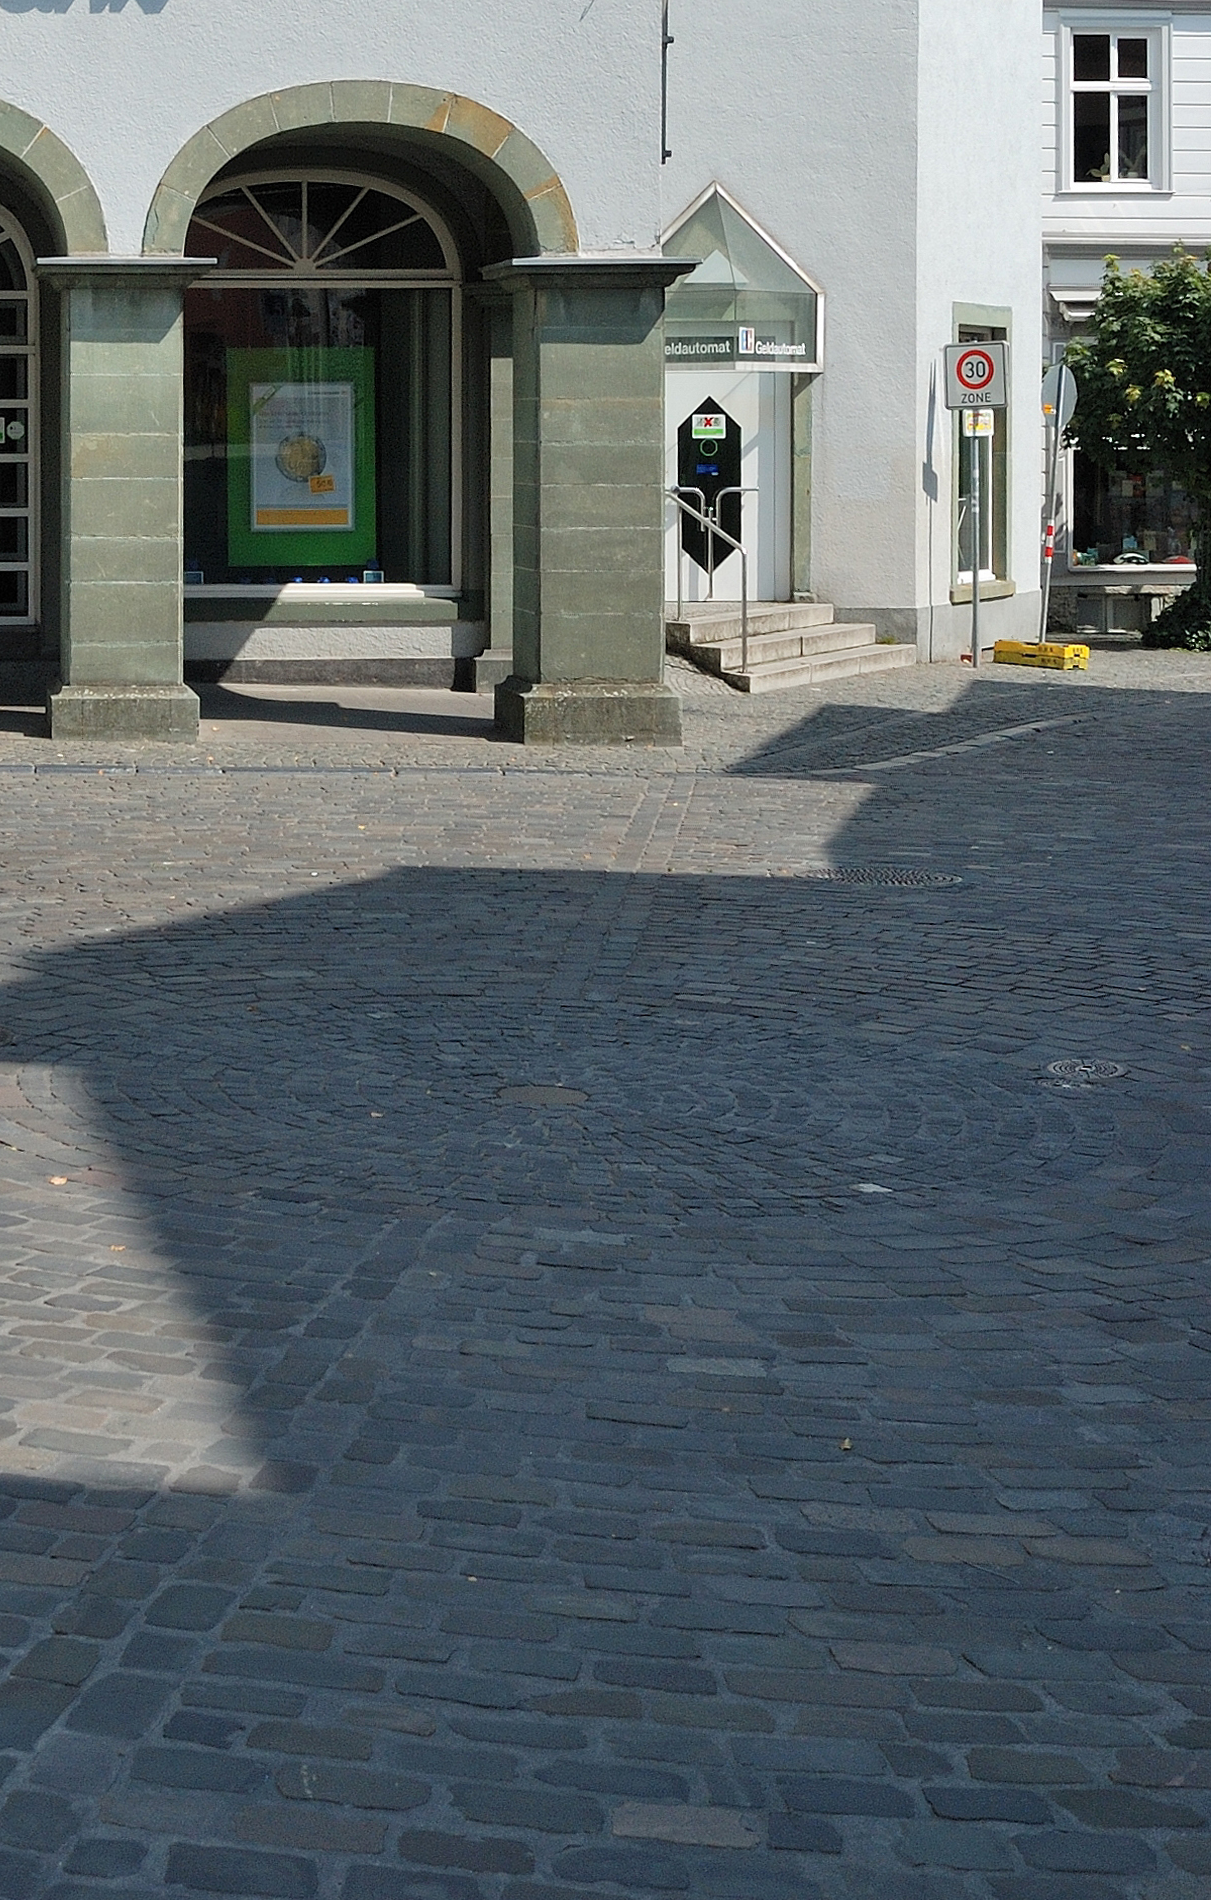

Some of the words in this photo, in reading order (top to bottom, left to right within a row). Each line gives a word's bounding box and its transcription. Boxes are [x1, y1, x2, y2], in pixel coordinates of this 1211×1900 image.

[664, 340, 731, 356] eldautomat
[755, 340, 807, 356] Geldautomat
[964, 360, 986, 379] 30
[961, 392, 992, 404] ZONE
